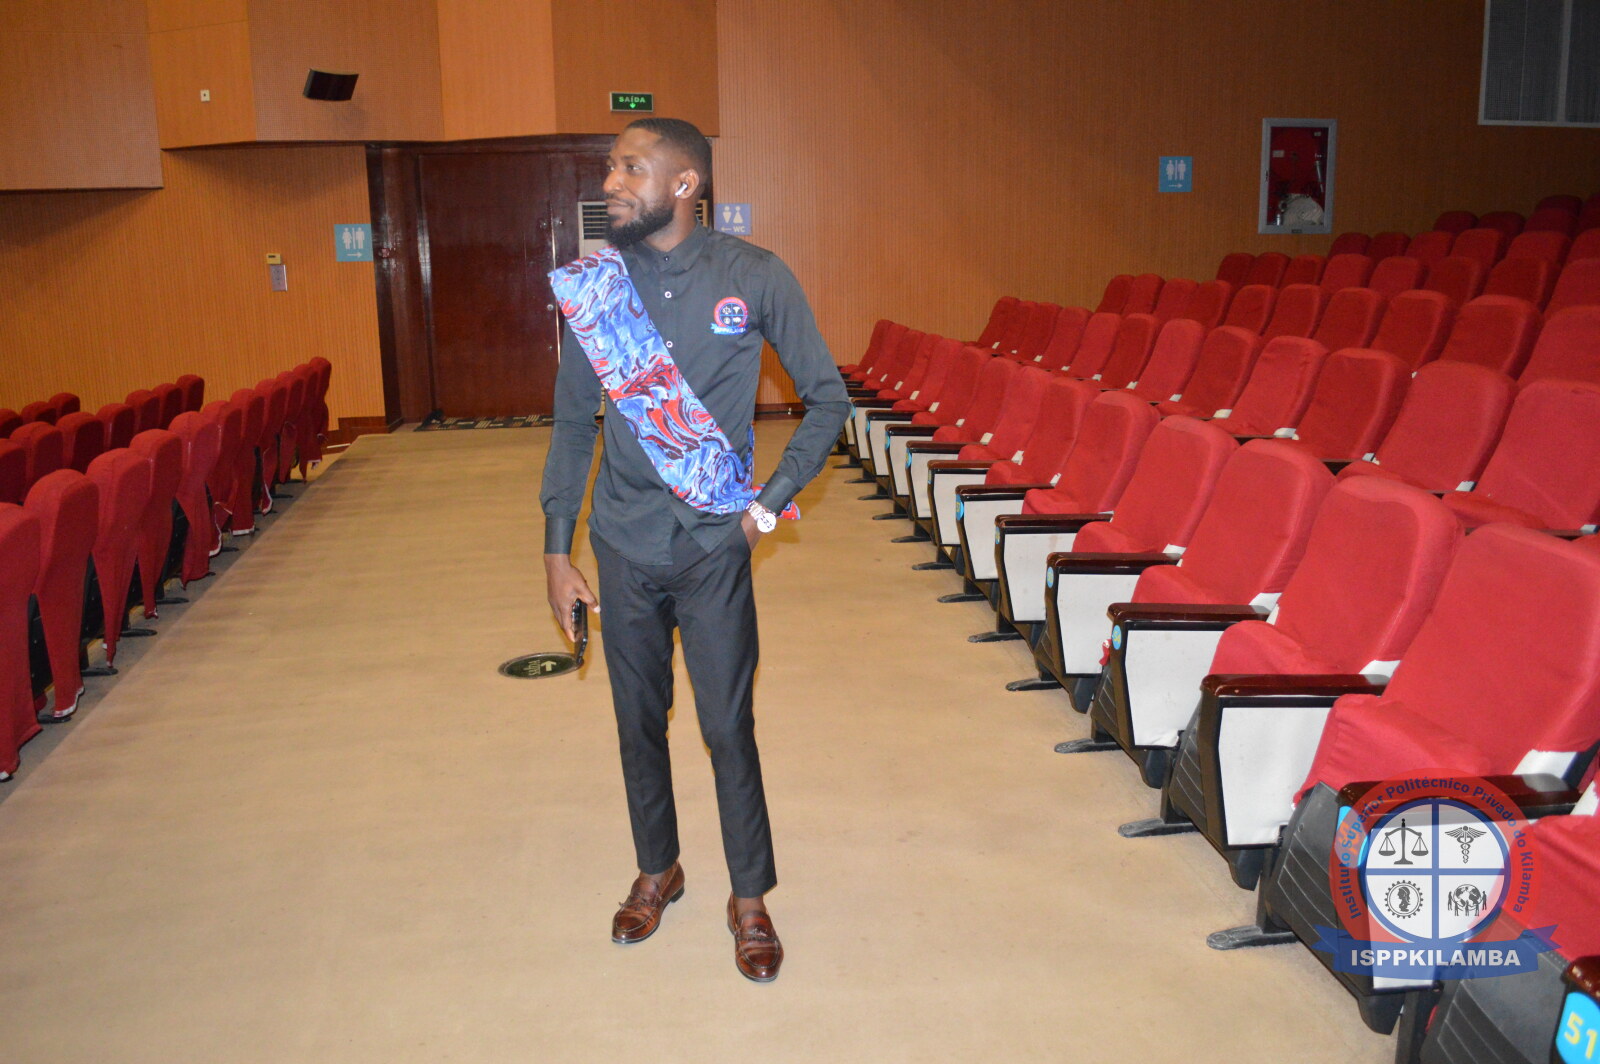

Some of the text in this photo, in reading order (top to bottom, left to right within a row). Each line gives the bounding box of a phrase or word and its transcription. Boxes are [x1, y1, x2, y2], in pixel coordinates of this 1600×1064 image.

[618, 95, 646, 103] SAÍDA
[733, 225, 746, 233] WC
[1564, 1010, 1598, 1060] 51
